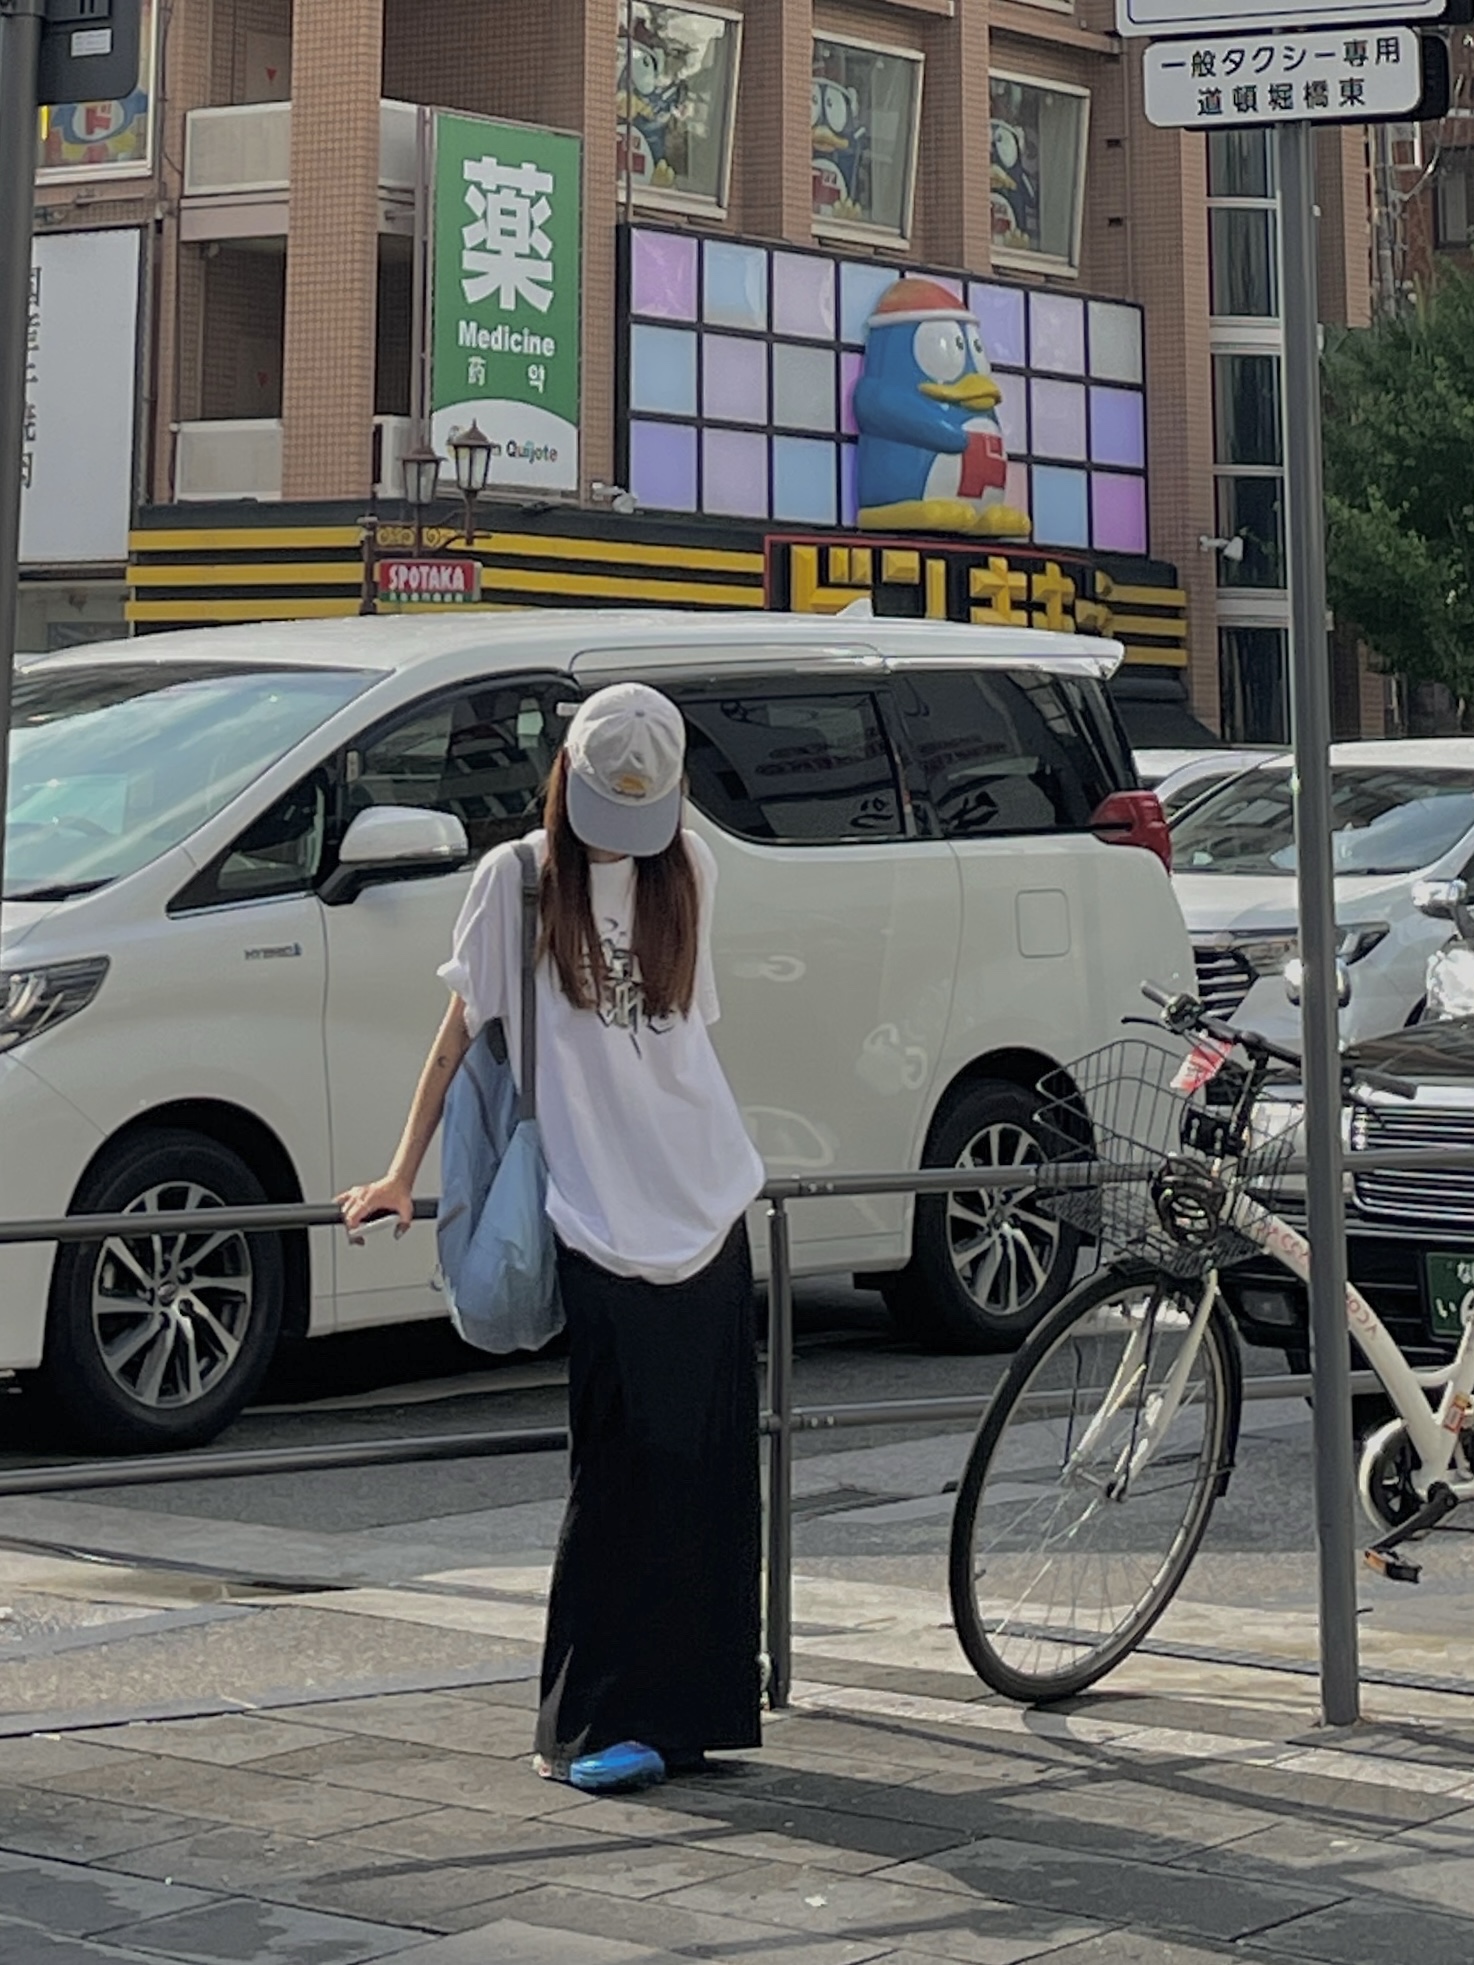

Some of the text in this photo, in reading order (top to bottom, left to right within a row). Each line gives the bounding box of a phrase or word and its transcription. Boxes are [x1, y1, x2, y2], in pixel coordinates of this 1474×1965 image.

[1161, 36, 1401, 78] 一般タクシー専用
[1197, 77, 1367, 116] 道頓堀橋東
[461, 155, 554, 314] 薬
[458, 319, 556, 357] Medicine
[506, 439, 559, 464] Quijote
[388, 564, 465, 591] SPOTAKA
